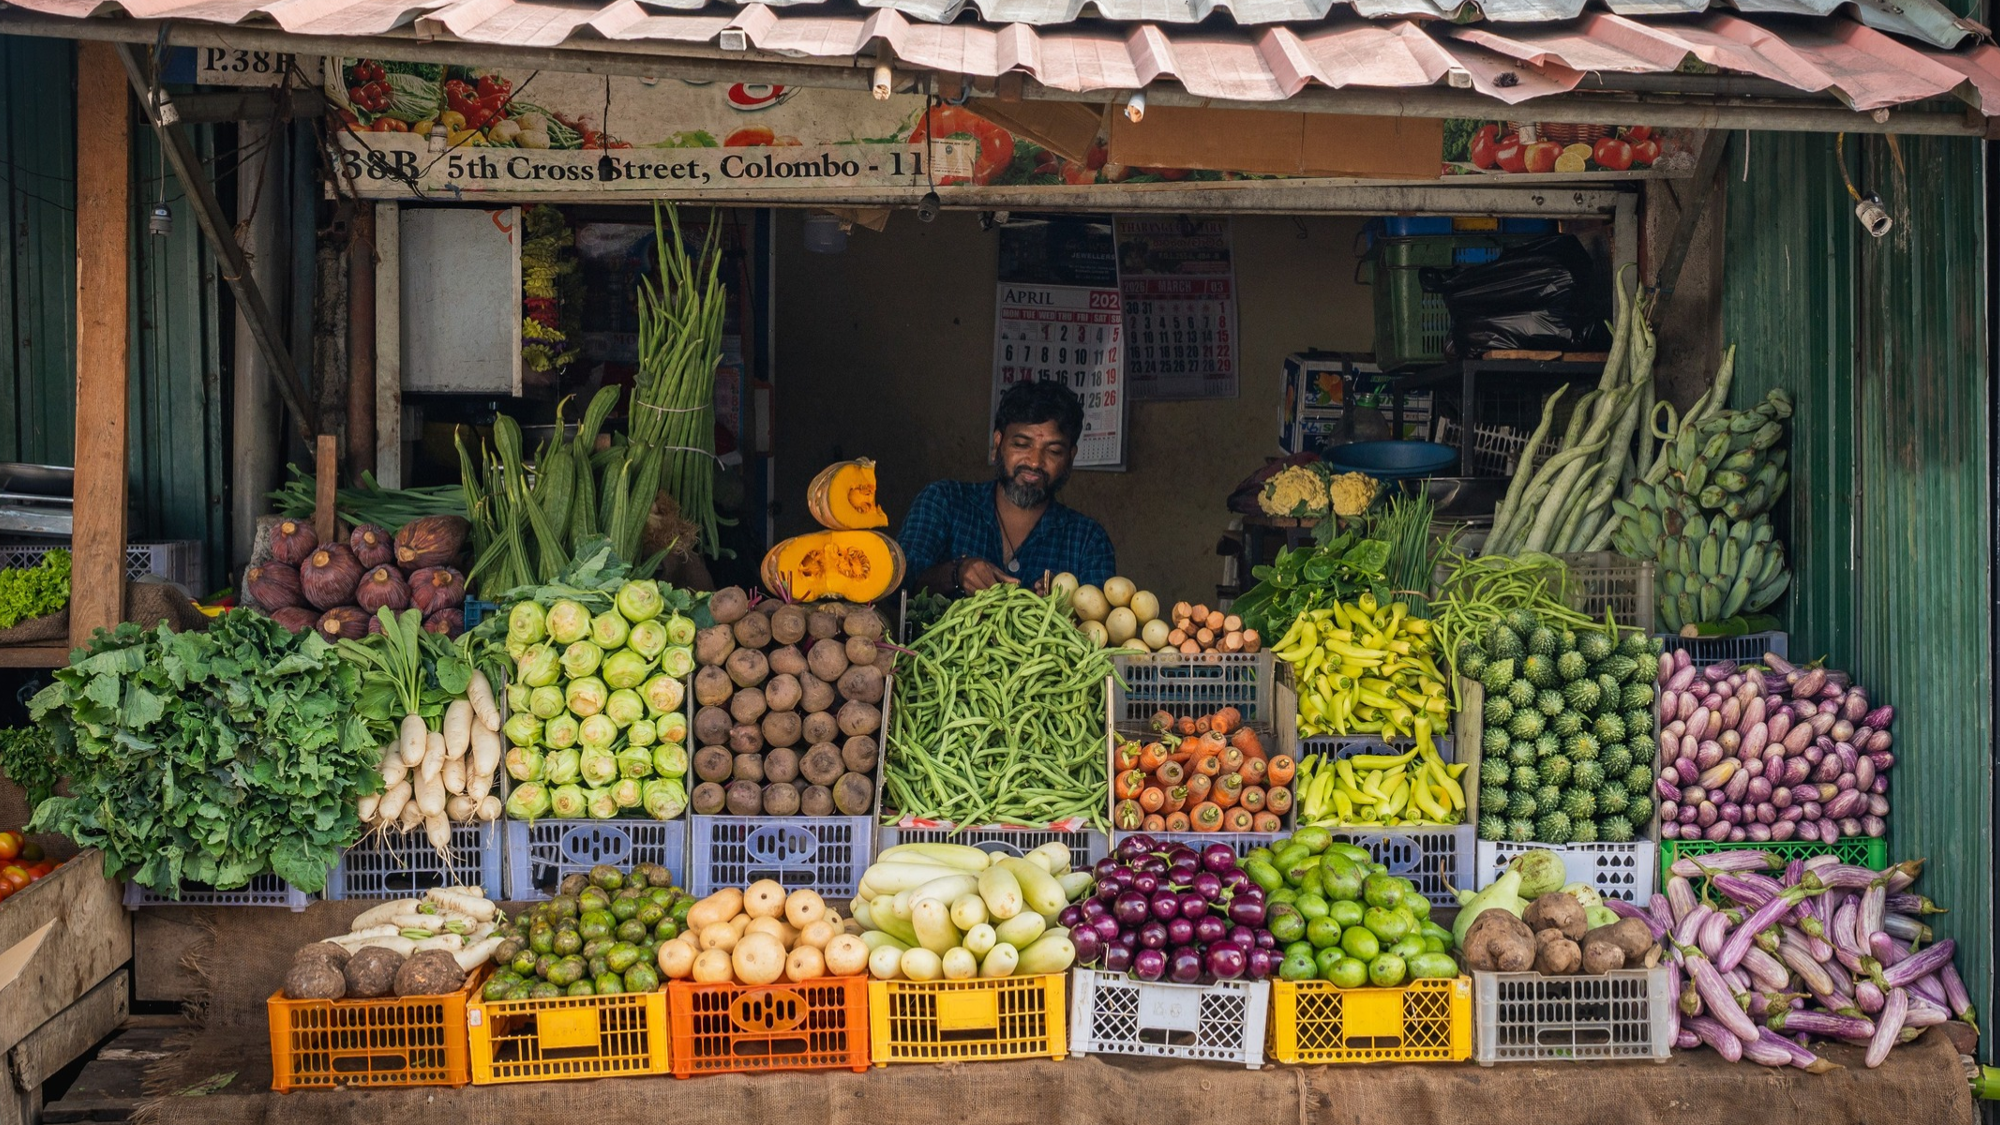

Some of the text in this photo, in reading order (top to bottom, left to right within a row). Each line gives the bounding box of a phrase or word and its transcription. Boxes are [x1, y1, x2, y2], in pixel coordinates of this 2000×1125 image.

[341, 150, 421, 180] 38B
[447, 153, 499, 180] 5th
[506, 156, 594, 180] Cross
[605, 157, 711, 185] Street,
[720, 153, 860, 179] Colombo
[891, 152, 926, 177] 11
[1124, 280, 1223, 293] 2026 MARCH 03
[1003, 288, 1054, 305] APRIL
[1091, 293, 1120, 308] 202
[1003, 308, 1122, 323] MON TUE WED THU FRI SAT SU
[1126, 302, 1139, 314] 30
[1142, 302, 1152, 314] 31
[1131, 316, 1226, 329] 2 3 4 5 6 7 8
[1060, 325, 1068, 342] 2
[1078, 326, 1086, 343] 3
[1096, 327, 1103, 344] 4
[1112, 328, 1120, 342] 5
[1131, 330, 1229, 344] 9 10 11 12 13 14 15
[1006, 344, 1117, 366] 6 7 8 9 10 11 12
[1130, 345, 1230, 358] 16 17 18 19 20 21 22
[1132, 359, 1230, 373] 23 24 25 26 27 28 29
[1002, 367, 1015, 384] 13
[1038, 369, 1050, 382] 15
[1056, 370, 1068, 386] 16
[1074, 371, 1086, 387] 17
[1092, 370, 1102, 387] 18
[1106, 368, 1116, 385] 19
[1088, 393, 1101, 408] 25
[1104, 390, 1116, 407] 26
